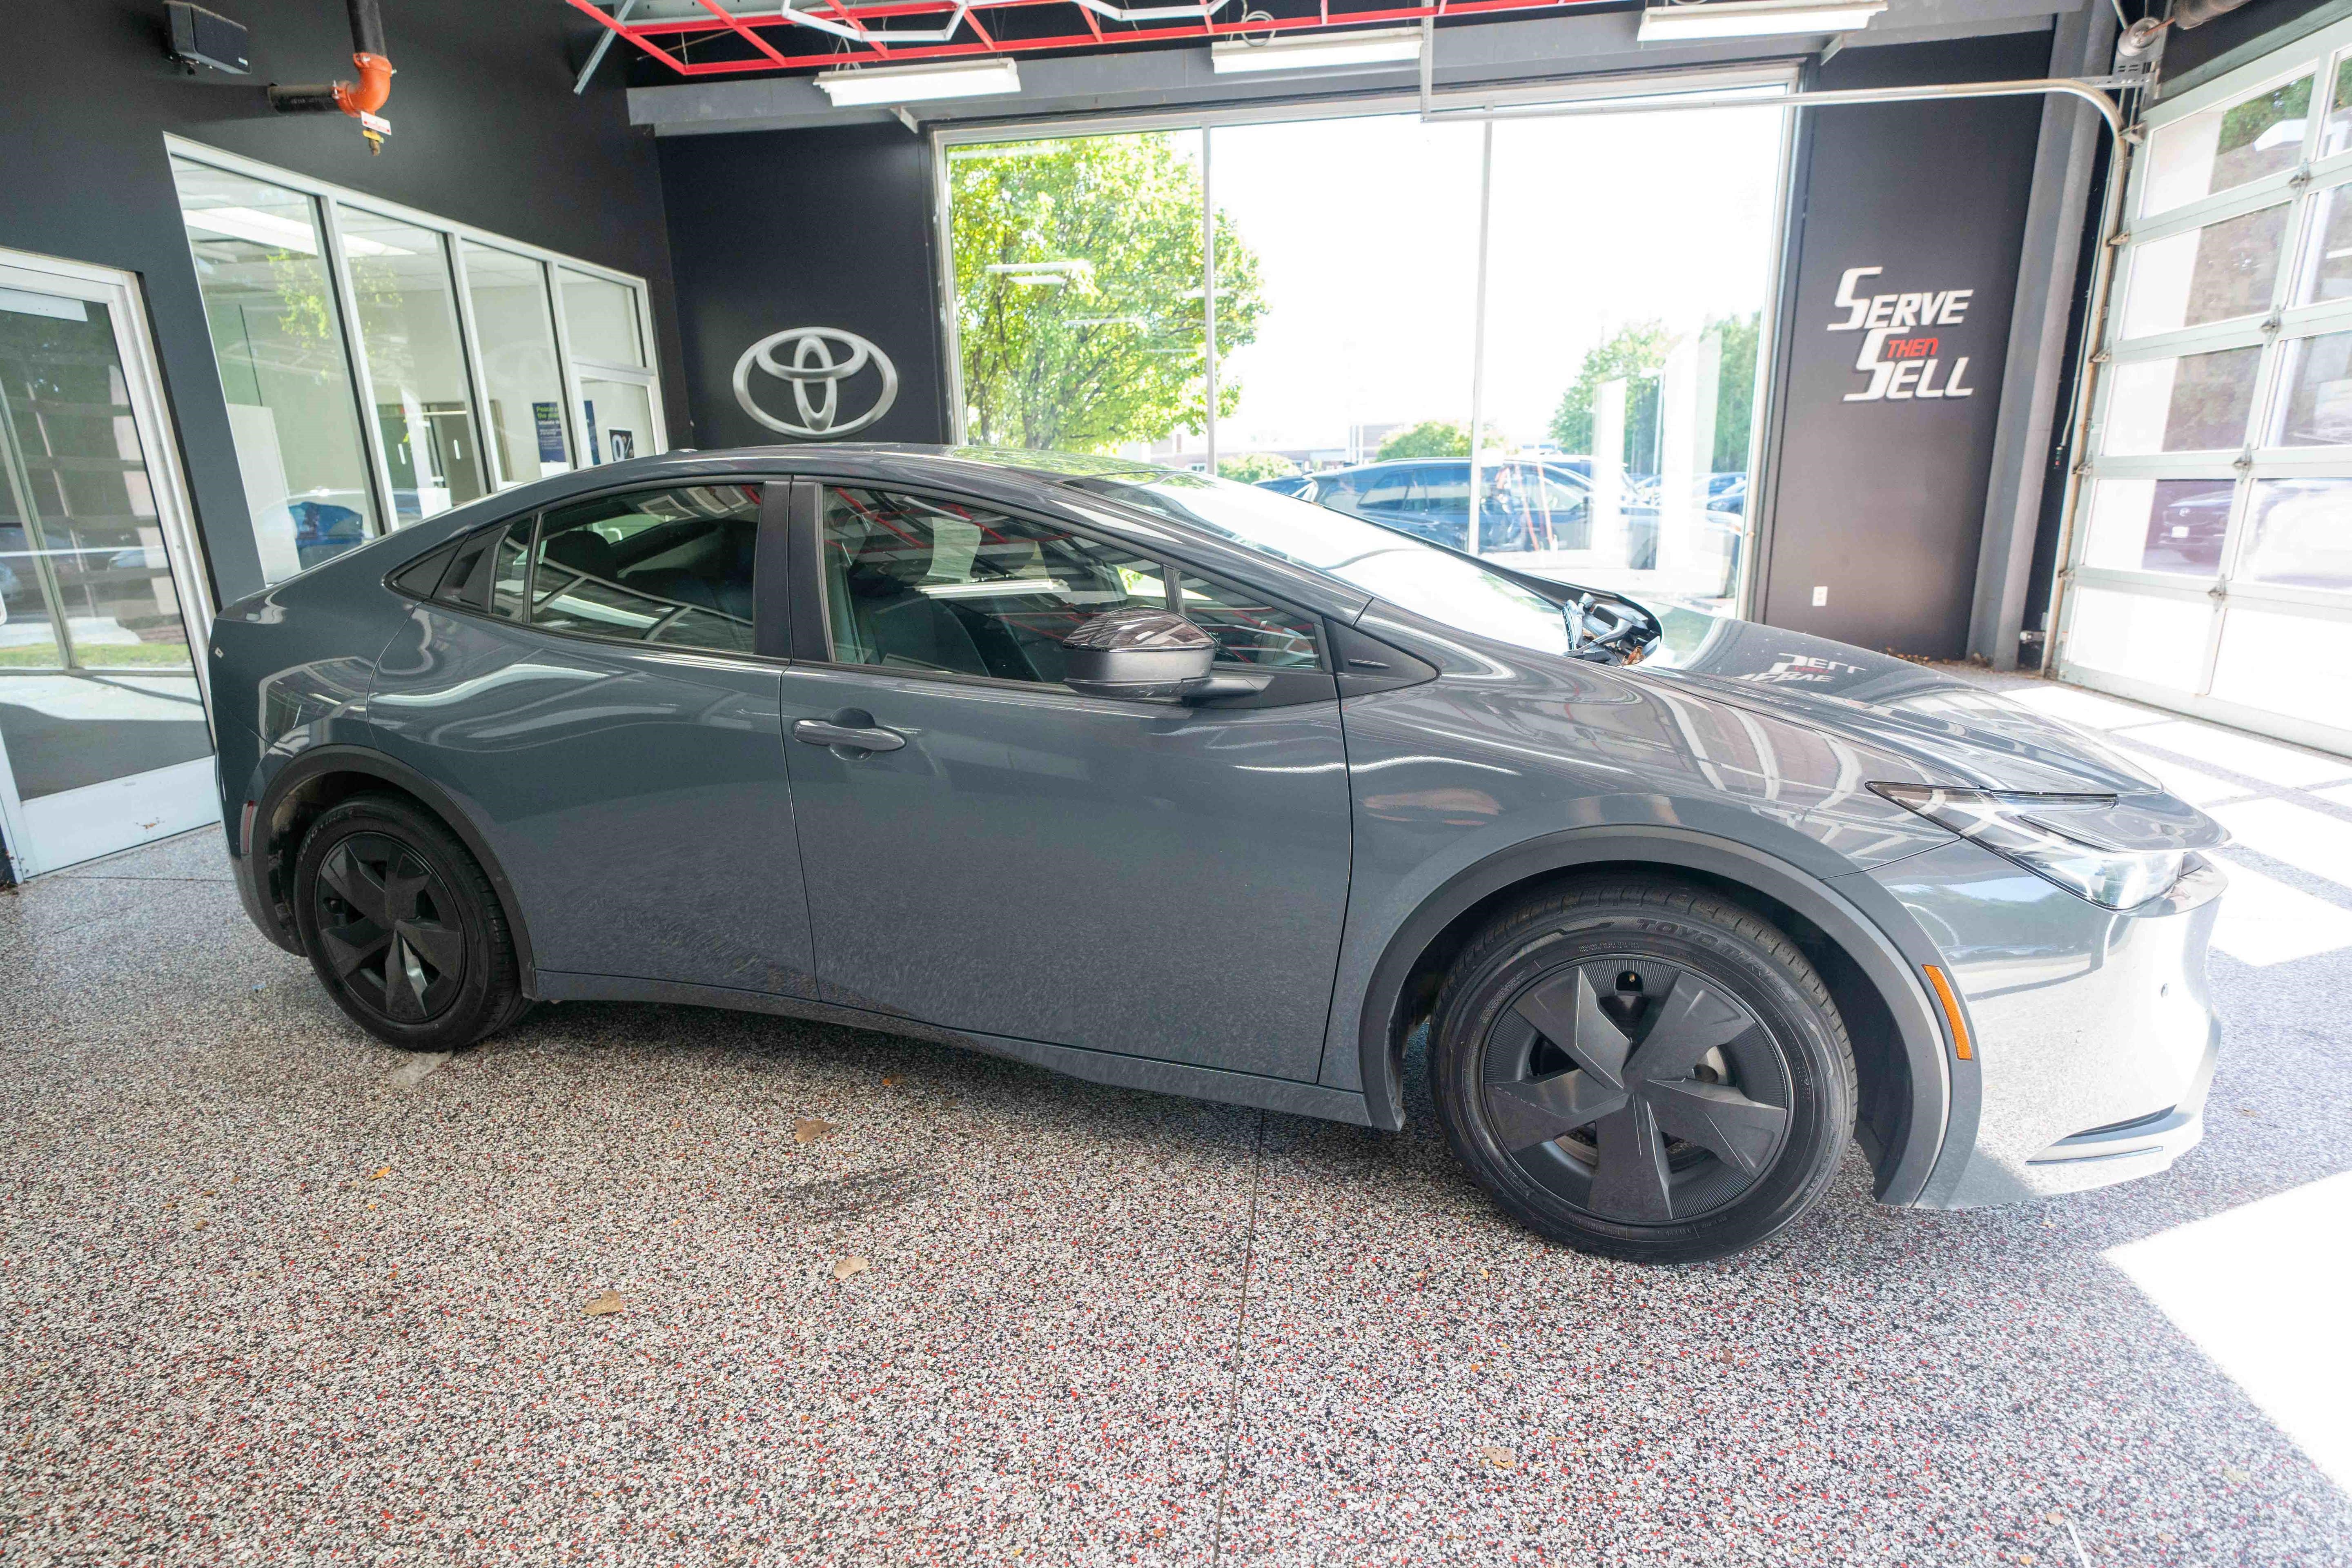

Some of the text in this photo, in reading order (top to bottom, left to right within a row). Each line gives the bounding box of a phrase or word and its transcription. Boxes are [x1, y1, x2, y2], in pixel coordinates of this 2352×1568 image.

[1826, 266, 1974, 331] SERVE
[1843, 326, 1974, 401] SELL
[1637, 918, 1719, 946] TOYO
[1719, 942, 1797, 1004] TIRES
